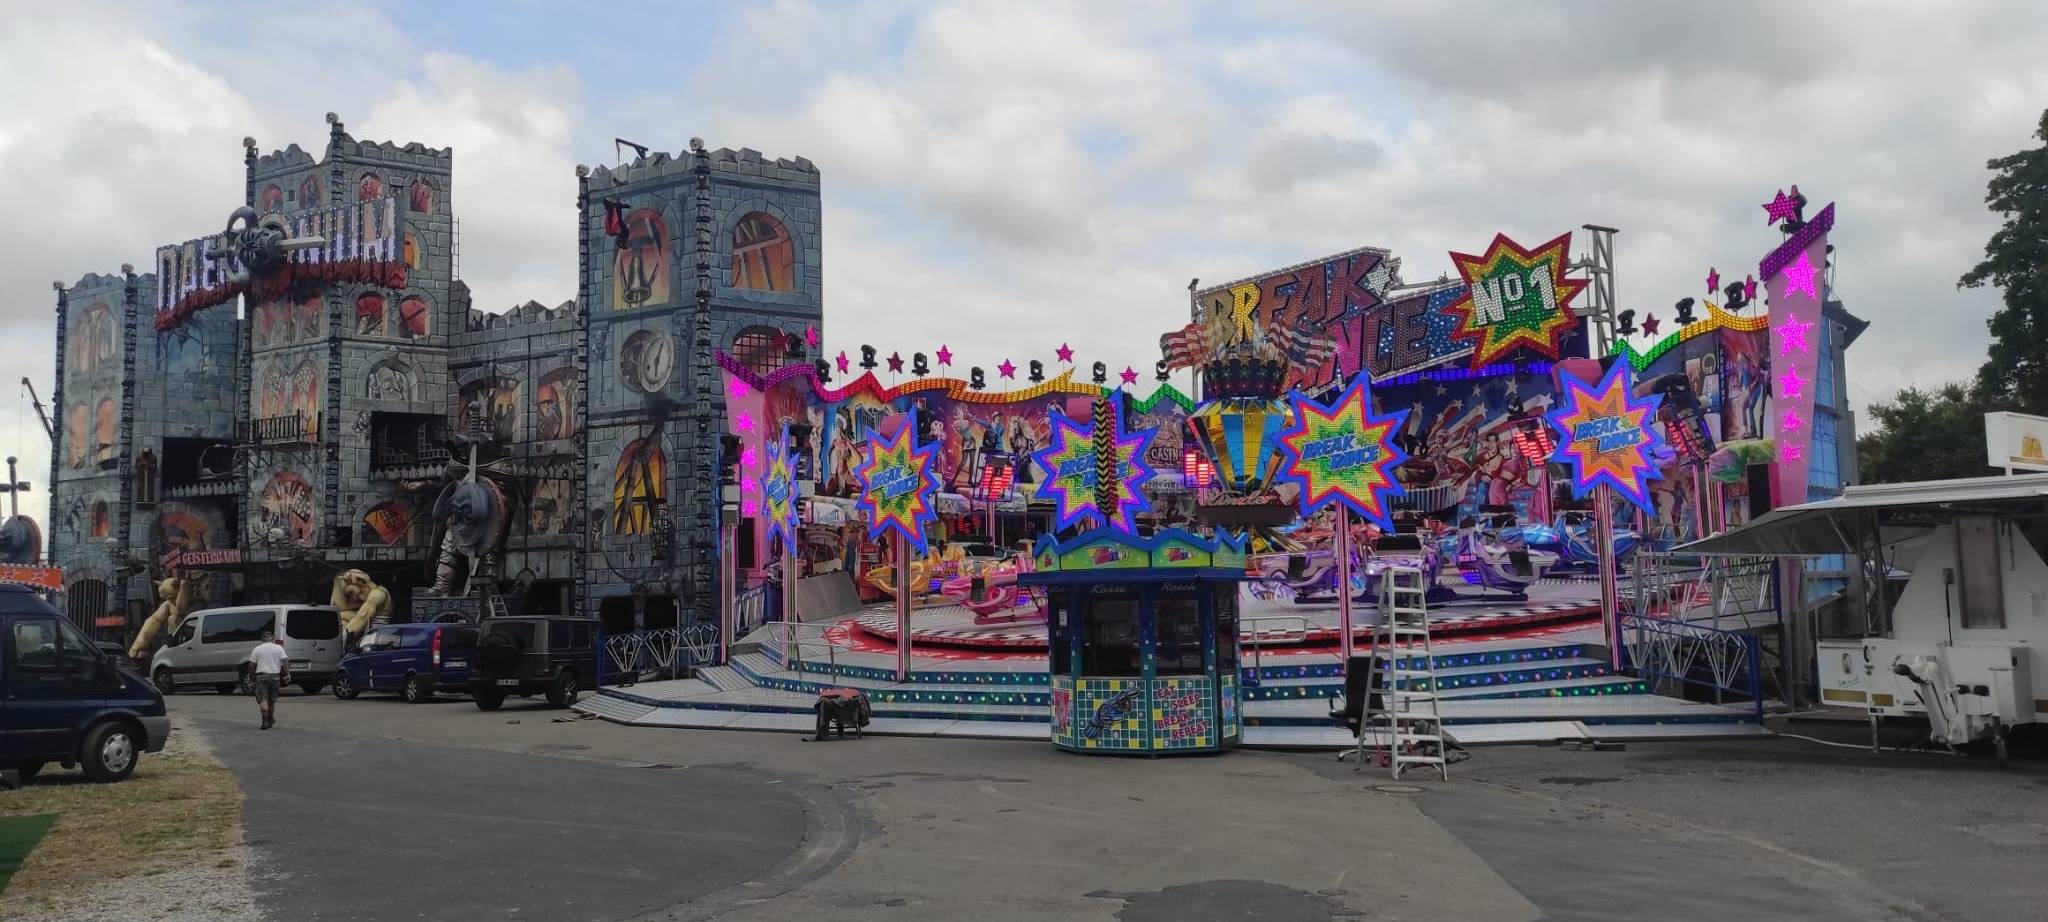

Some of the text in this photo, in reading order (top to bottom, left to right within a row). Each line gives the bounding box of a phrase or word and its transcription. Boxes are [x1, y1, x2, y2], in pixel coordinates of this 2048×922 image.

[1200, 252, 1388, 350] BREAK
[1574, 416, 1622, 442] BREAK
[1598, 427, 1642, 453] DANCE
[1301, 433, 1357, 461] BREAK
[1329, 443, 1380, 472] DANCE
[1156, 685, 1176, 699] EAT
[1172, 693, 1200, 710] SLEEP
[1156, 713, 1192, 730] BREAK
[1172, 721, 1209, 740] REPEAT
